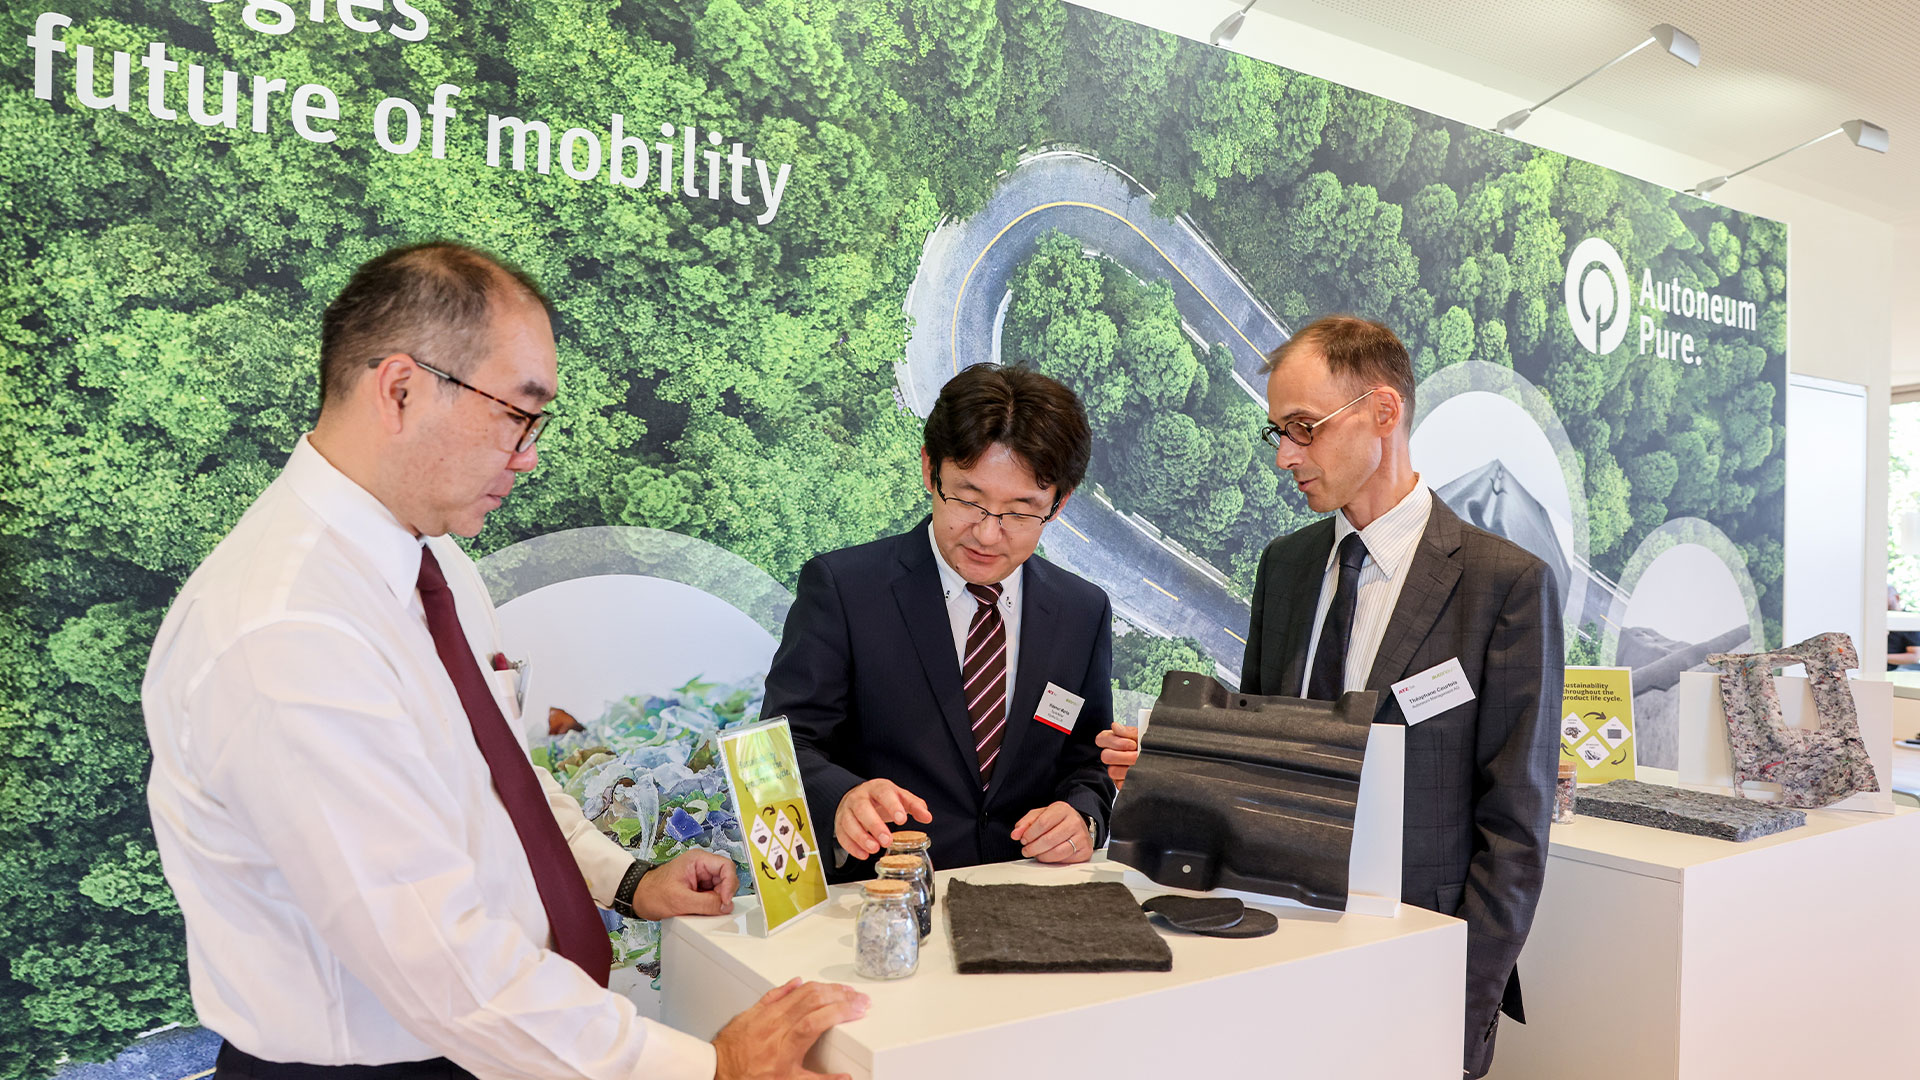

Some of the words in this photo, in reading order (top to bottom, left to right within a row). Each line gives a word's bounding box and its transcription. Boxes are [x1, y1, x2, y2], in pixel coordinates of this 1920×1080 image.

[27, 12, 340, 143] future
[373, 83, 461, 159] of
[487, 113, 791, 225] mobility
[1638, 268, 1756, 331] Autoneum
[1640, 315, 1702, 366] Pure.
[1563, 682, 1608, 690] ustainability
